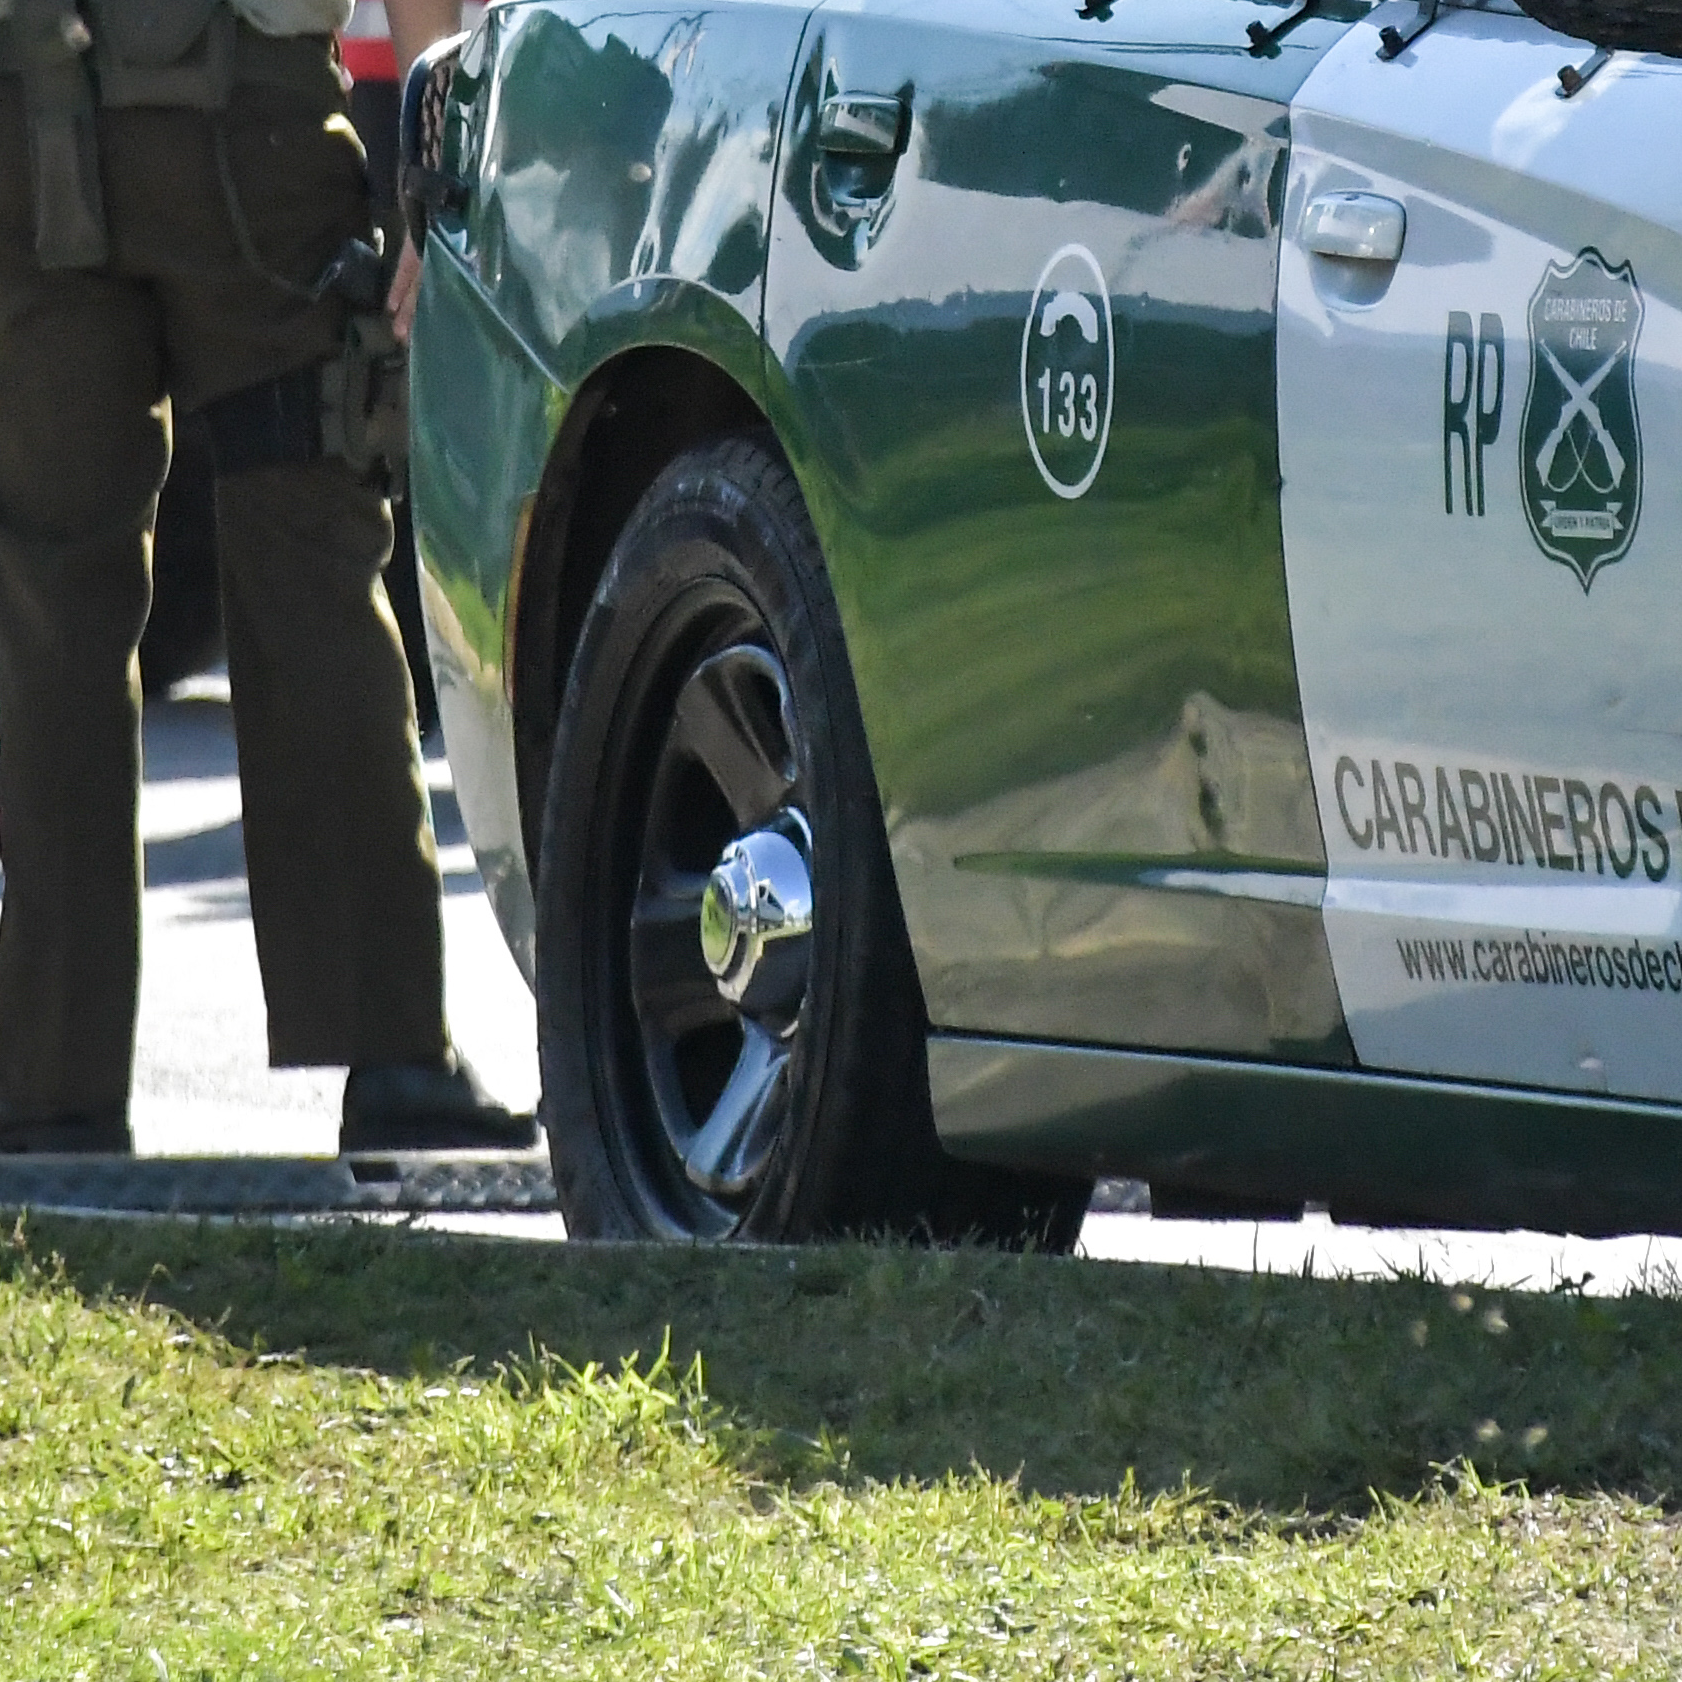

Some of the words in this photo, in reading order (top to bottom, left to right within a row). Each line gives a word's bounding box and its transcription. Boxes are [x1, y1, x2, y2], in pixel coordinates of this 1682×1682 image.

[1544, 298, 1611, 323] CARABINEROS
[1614, 299, 1628, 323] DE
[1569, 327, 1598, 351] CHILE
[1037, 367, 1099, 442] 133
[1443, 311, 1505, 517] RP
[1333, 755, 1672, 884] CARABINEROS
